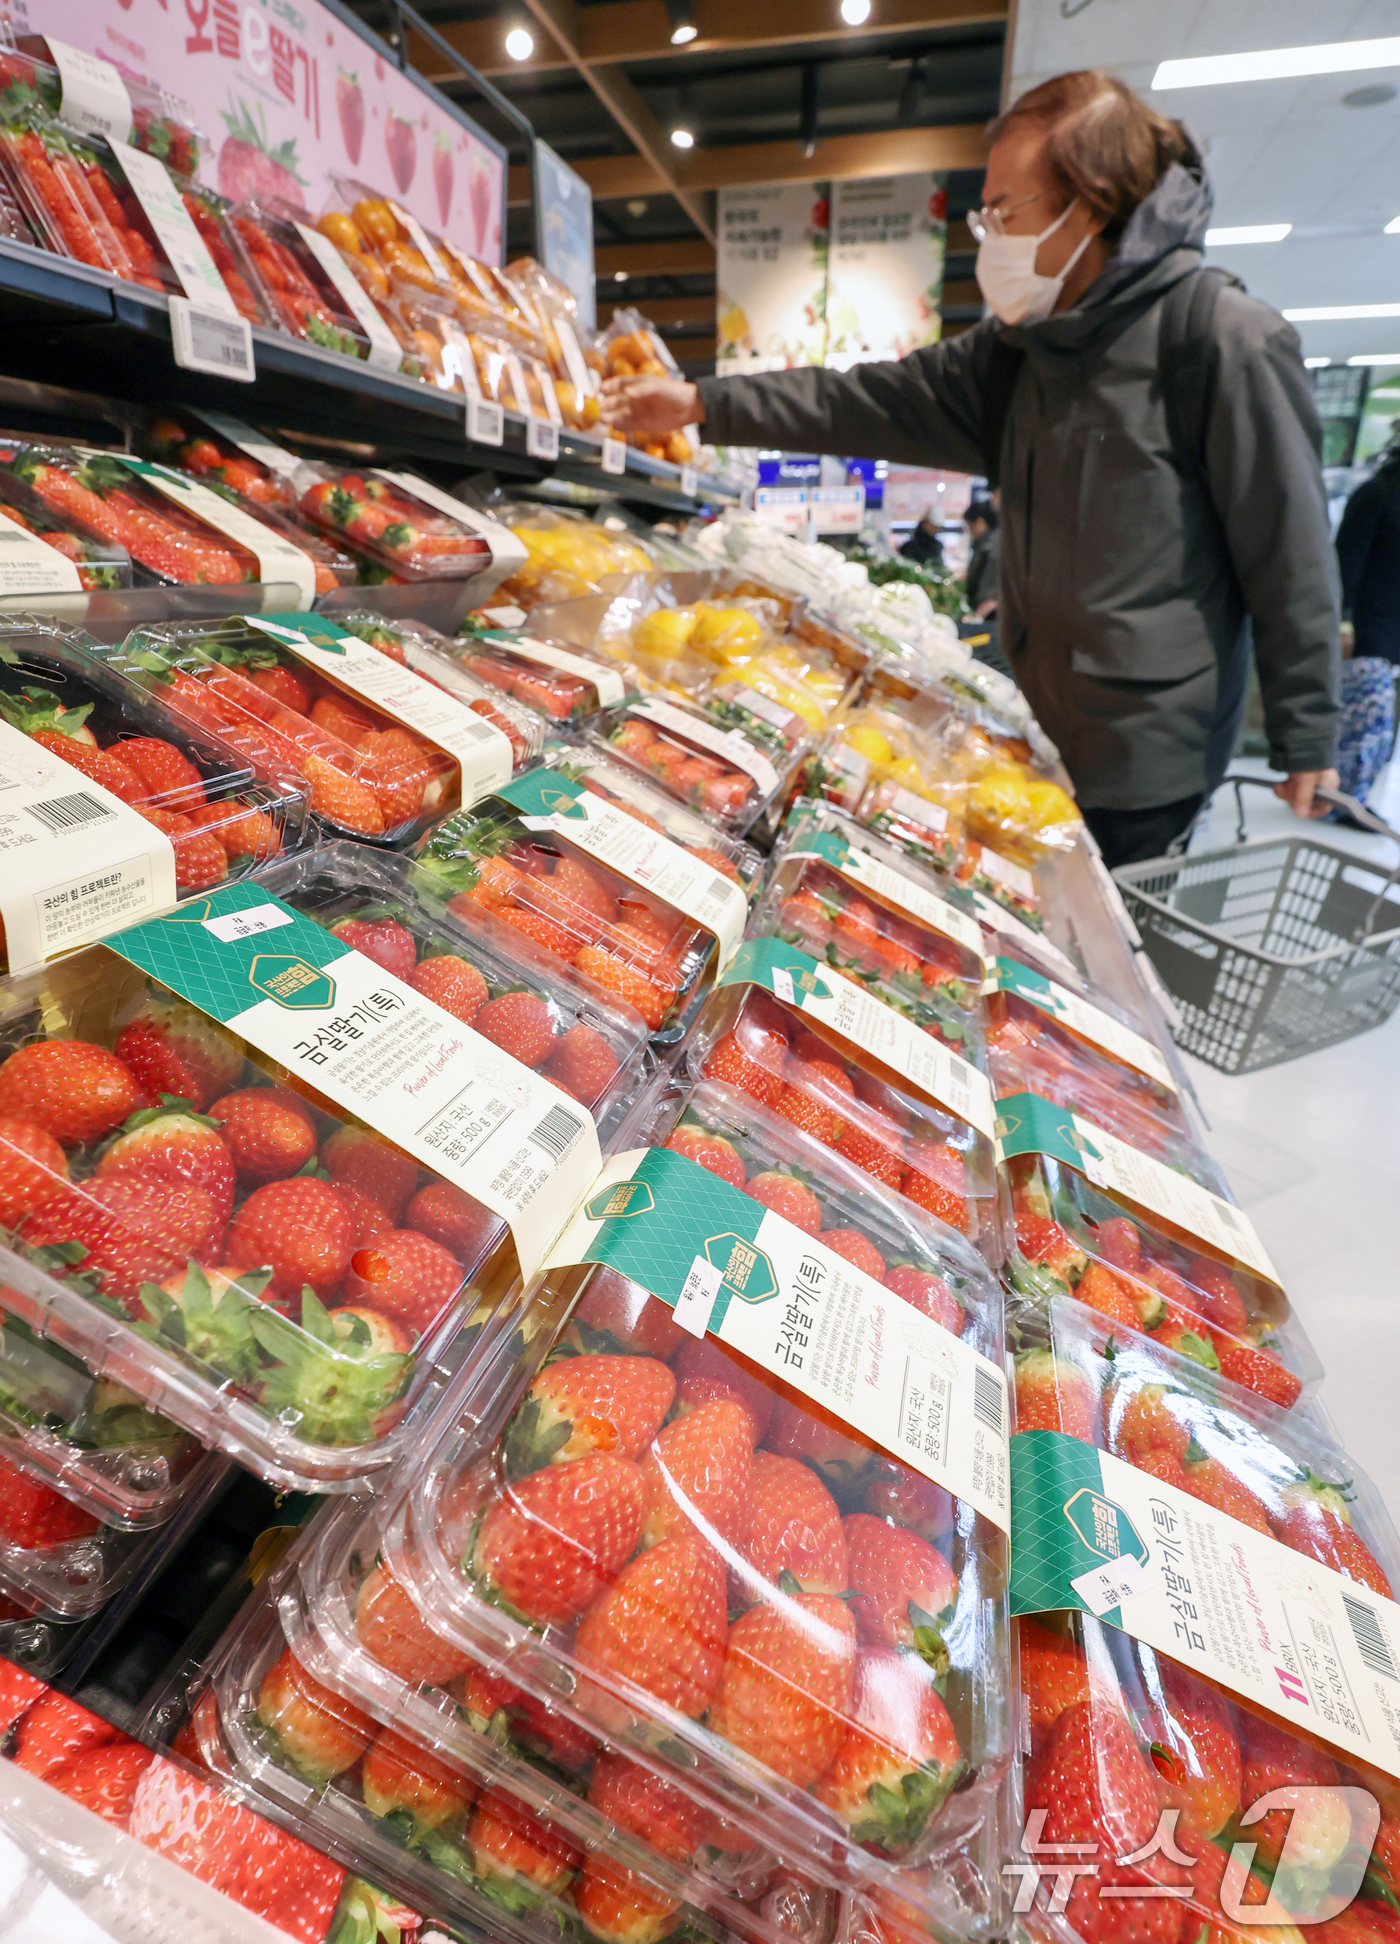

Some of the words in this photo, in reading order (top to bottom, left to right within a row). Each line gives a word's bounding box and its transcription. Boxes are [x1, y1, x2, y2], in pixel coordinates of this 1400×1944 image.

[60, 824, 89, 837] 500000
[90, 814, 118, 826] 111150
[14, 832, 38, 848] 드세요
[43, 891, 68, 909] 국산의
[69, 887, 79, 901] 힘
[80, 872, 121, 896] 프로젝트란?
[111, 896, 117, 905] 더
[44, 913, 52, 922] 이
[111, 900, 131, 915] 프로젝트
[263, 971, 294, 989] 국산의
[288, 962, 321, 986] 힘
[294, 988, 404, 1064] 금실딸기(특)
[439, 1038, 463, 1058] Foods
[424, 1064, 438, 1077] of
[427, 1050, 449, 1072] Local
[402, 1074, 428, 1097] Power
[478, 1116, 491, 1127] g
[514, 1147, 532, 1163] 신고는
[518, 1165, 534, 1180] 1399
[532, 1168, 550, 1190] 드세요
[731, 1240, 757, 1269] 힘
[723, 1256, 739, 1281] 국산의
[775, 1254, 827, 1368] 금실딸기(특)
[869, 1304, 886, 1330] Foods
[867, 1324, 883, 1352] Local
[868, 1346, 883, 1361] of
[864, 1359, 880, 1389] Power
[931, 1399, 944, 1411] g
[985, 1451, 995, 1470] 1399
[1091, 1496, 1119, 1529] 힘
[1094, 1523, 1107, 1551] 국산의
[1228, 1542, 1250, 1574] Foods
[1149, 1497, 1205, 1650] 금실딸기(특)
[1235, 1569, 1259, 1603] Local
[1245, 1599, 1262, 1616] of
[1255, 1616, 1277, 1655] Power
[1278, 1639, 1299, 1674] BRIX
[1322, 1653, 1337, 1667] g
[1273, 1666, 1309, 1705] 11
